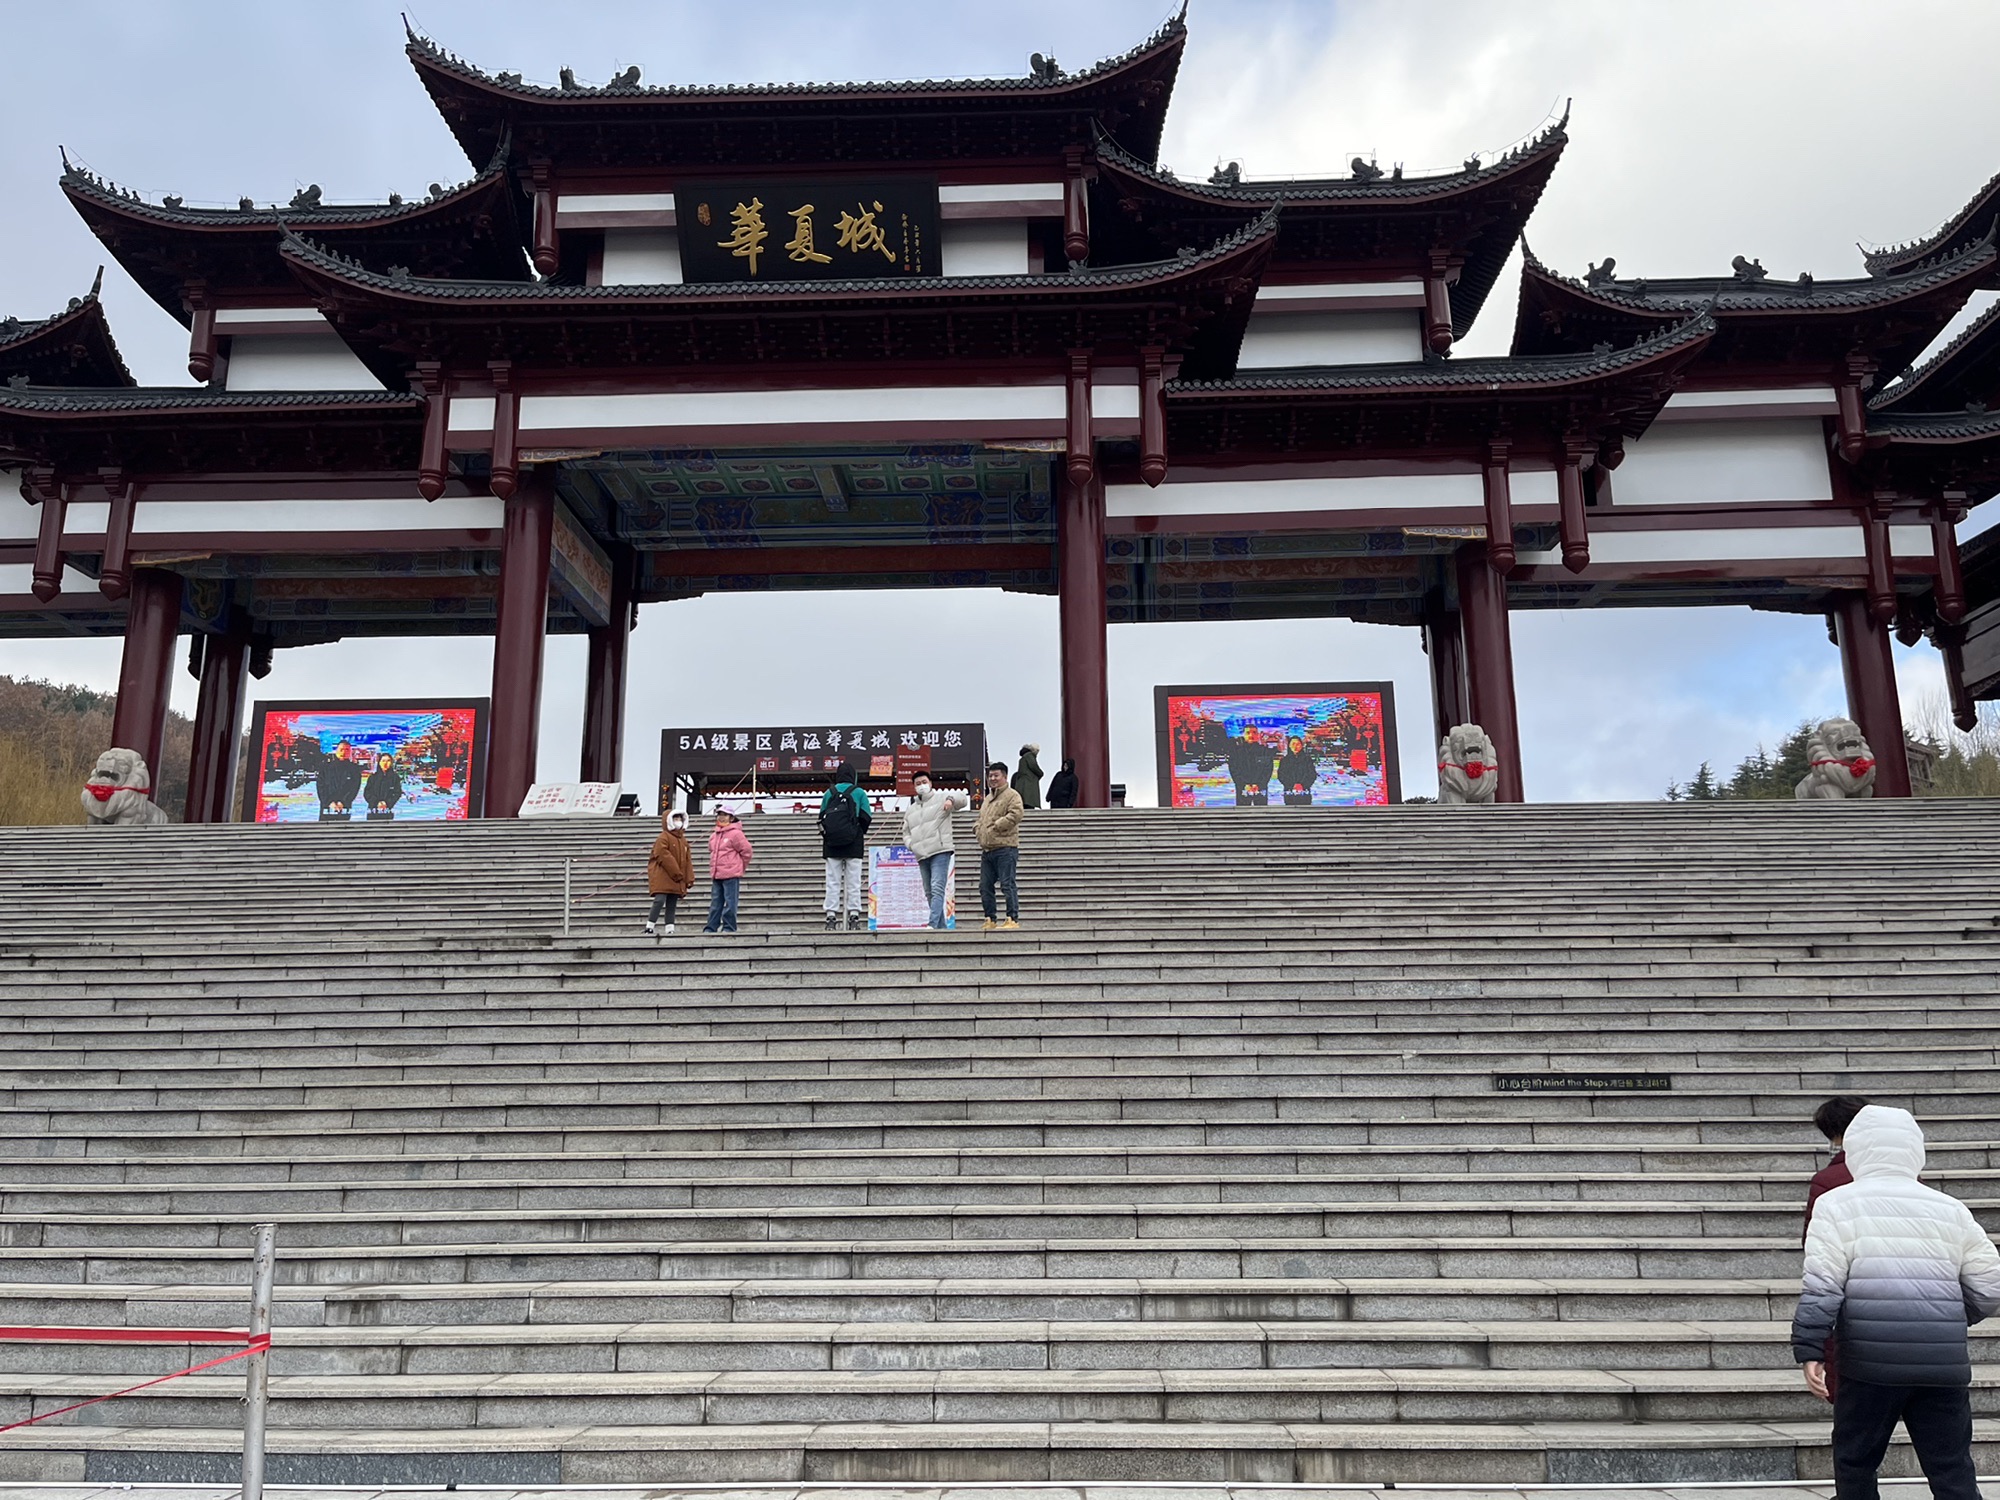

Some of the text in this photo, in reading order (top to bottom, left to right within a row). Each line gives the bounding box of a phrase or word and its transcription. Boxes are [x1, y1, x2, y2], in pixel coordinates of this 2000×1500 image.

[791, 760, 812, 768] 通道2
[1499, 1078, 1542, 1089] 小心台阶
[1543, 1078, 1565, 1087] Mind
[1567, 1079, 1582, 1087] the
[1584, 1079, 1608, 1088] Steps
